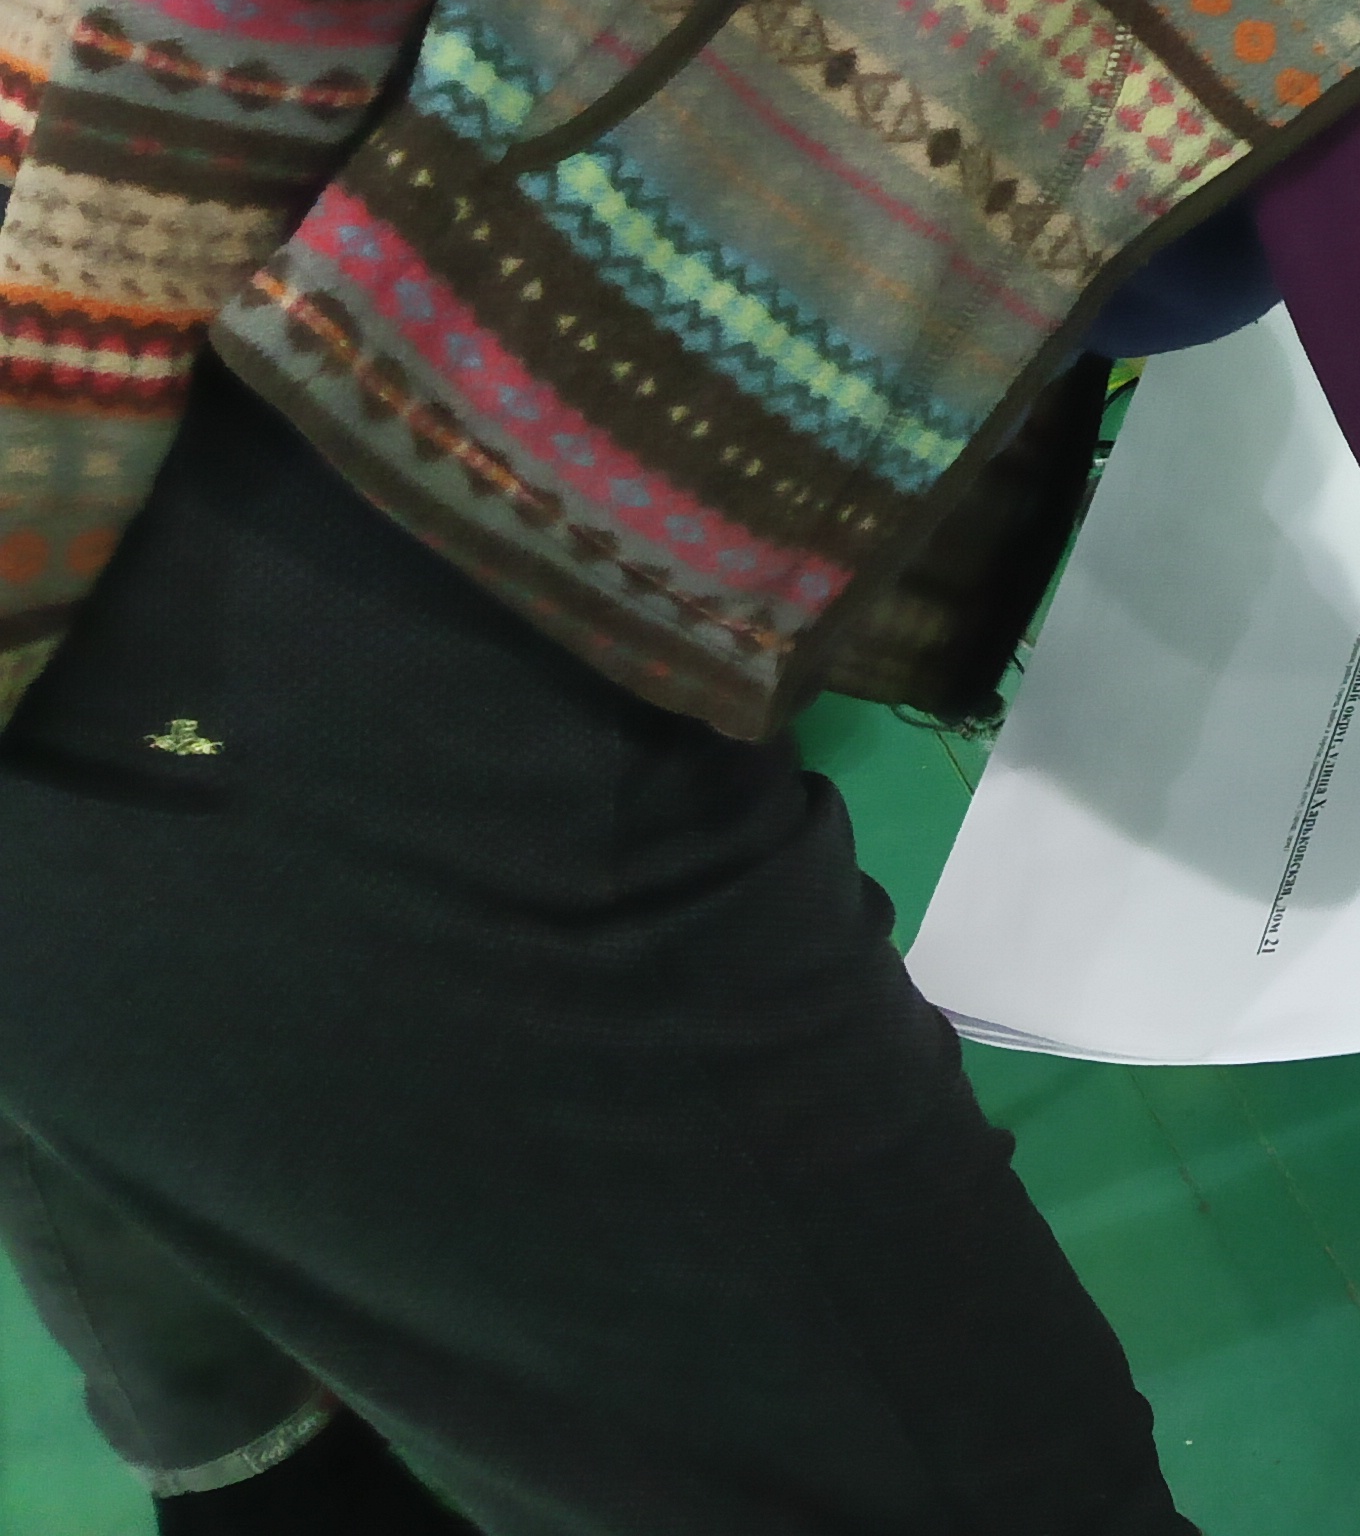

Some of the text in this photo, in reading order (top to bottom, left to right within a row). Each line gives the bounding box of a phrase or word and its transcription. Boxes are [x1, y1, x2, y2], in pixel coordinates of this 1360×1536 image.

[1313, 750, 1340, 797] улица
[1276, 795, 1327, 903] Харьковская,
[1267, 902, 1287, 935] дом
[1260, 936, 1279, 956] 21
